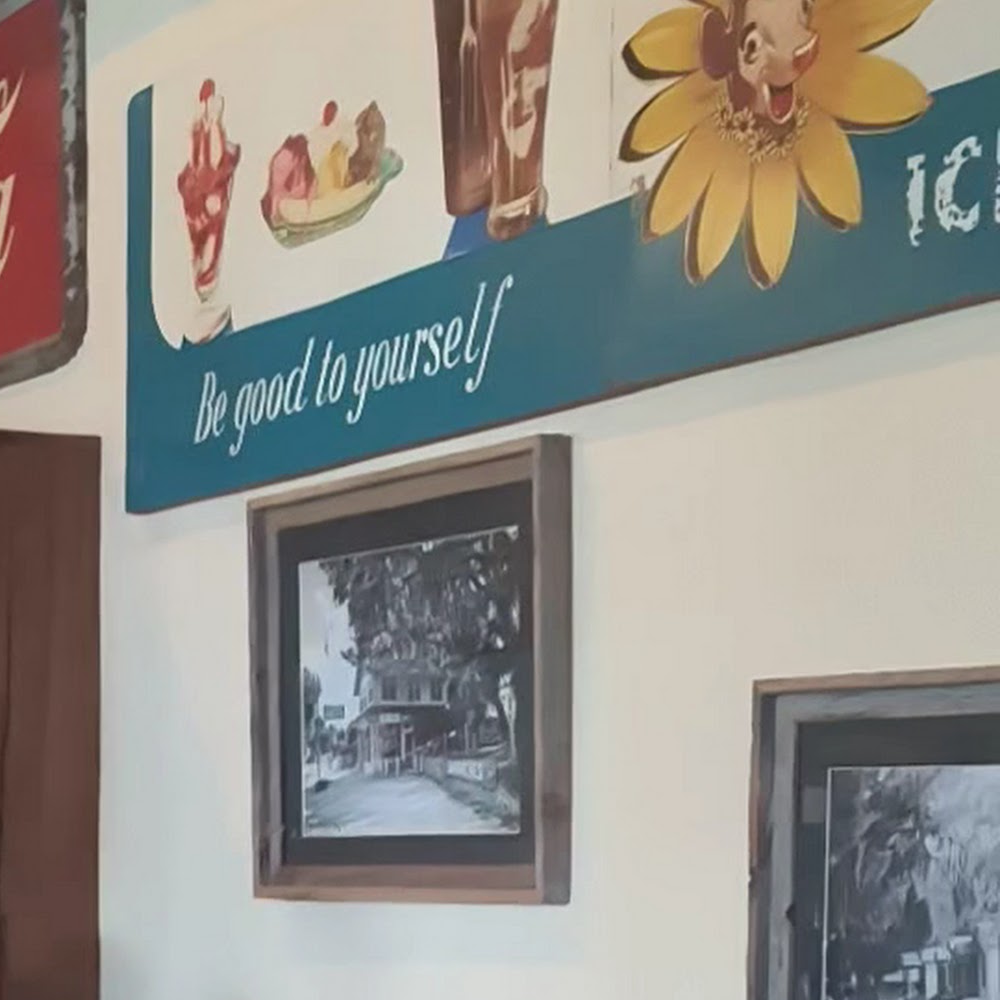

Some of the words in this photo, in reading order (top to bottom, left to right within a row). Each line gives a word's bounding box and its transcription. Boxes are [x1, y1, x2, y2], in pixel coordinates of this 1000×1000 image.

[906, 128, 1000, 247] IC
[194, 370, 227, 445] Be
[229, 336, 315, 456] good
[315, 340, 347, 408] to
[346, 274, 514, 424] yourself
